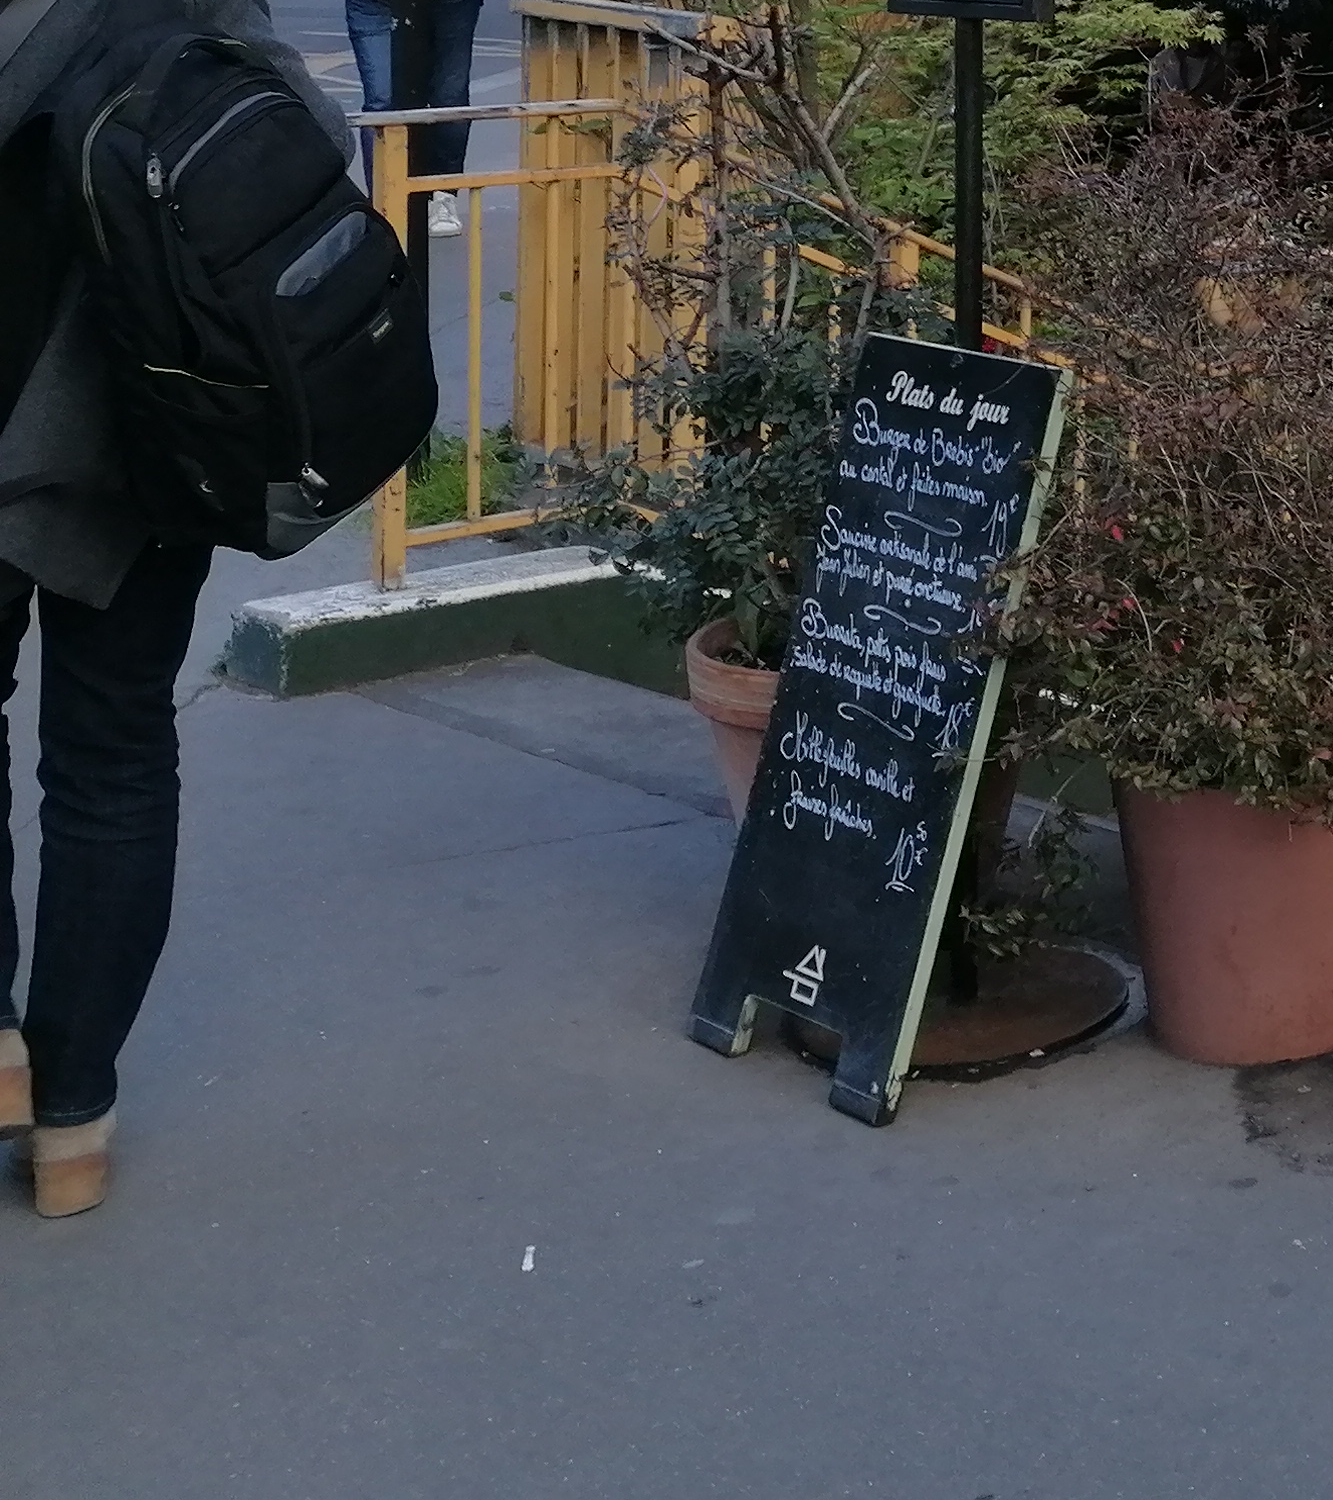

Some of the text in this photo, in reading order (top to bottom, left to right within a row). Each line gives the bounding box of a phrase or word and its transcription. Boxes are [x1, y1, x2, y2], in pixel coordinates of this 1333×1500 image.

[852, 397, 912, 460] Burger
[913, 428, 929, 455] de
[886, 370, 1011, 432] Plats du jour
